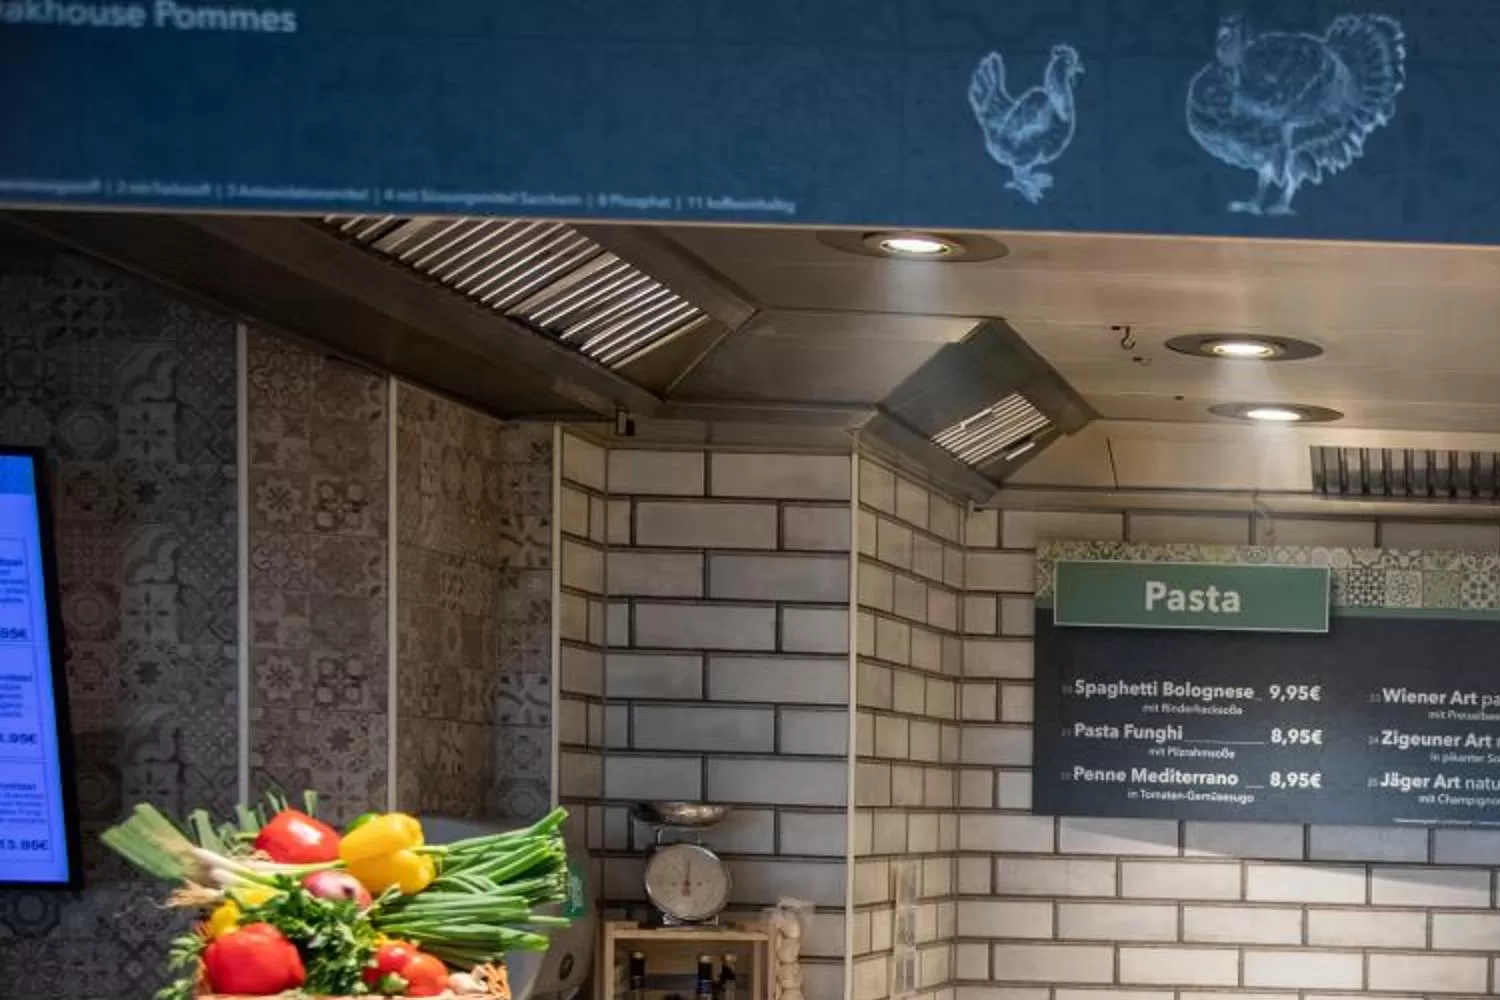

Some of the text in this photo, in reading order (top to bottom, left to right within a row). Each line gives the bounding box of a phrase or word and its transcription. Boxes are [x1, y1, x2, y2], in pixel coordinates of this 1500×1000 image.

[153, 0, 299, 33] Pommes
[1145, 579, 1242, 614] Pasta
[1075, 679, 1158, 699] Spaghetti
[1162, 681, 1256, 701] Bolognese
[1269, 684, 1321, 702] 9,95€
[1382, 687, 1446, 705] Wiener
[1449, 689, 1478, 705] Art
[1074, 722, 1119, 739] Pasta
[1123, 722, 1184, 744] Funghi
[1271, 728, 1323, 746] 8,95€
[1381, 729, 1461, 750] Zigeuner
[1464, 732, 1492, 748] Art
[1073, 765, 1127, 782] Penne
[1131, 767, 1240, 786] Mediterrano
[1269, 771, 1322, 789] 8,95€
[1380, 771, 1430, 793] Jäger
[1433, 773, 1460, 789] Art
